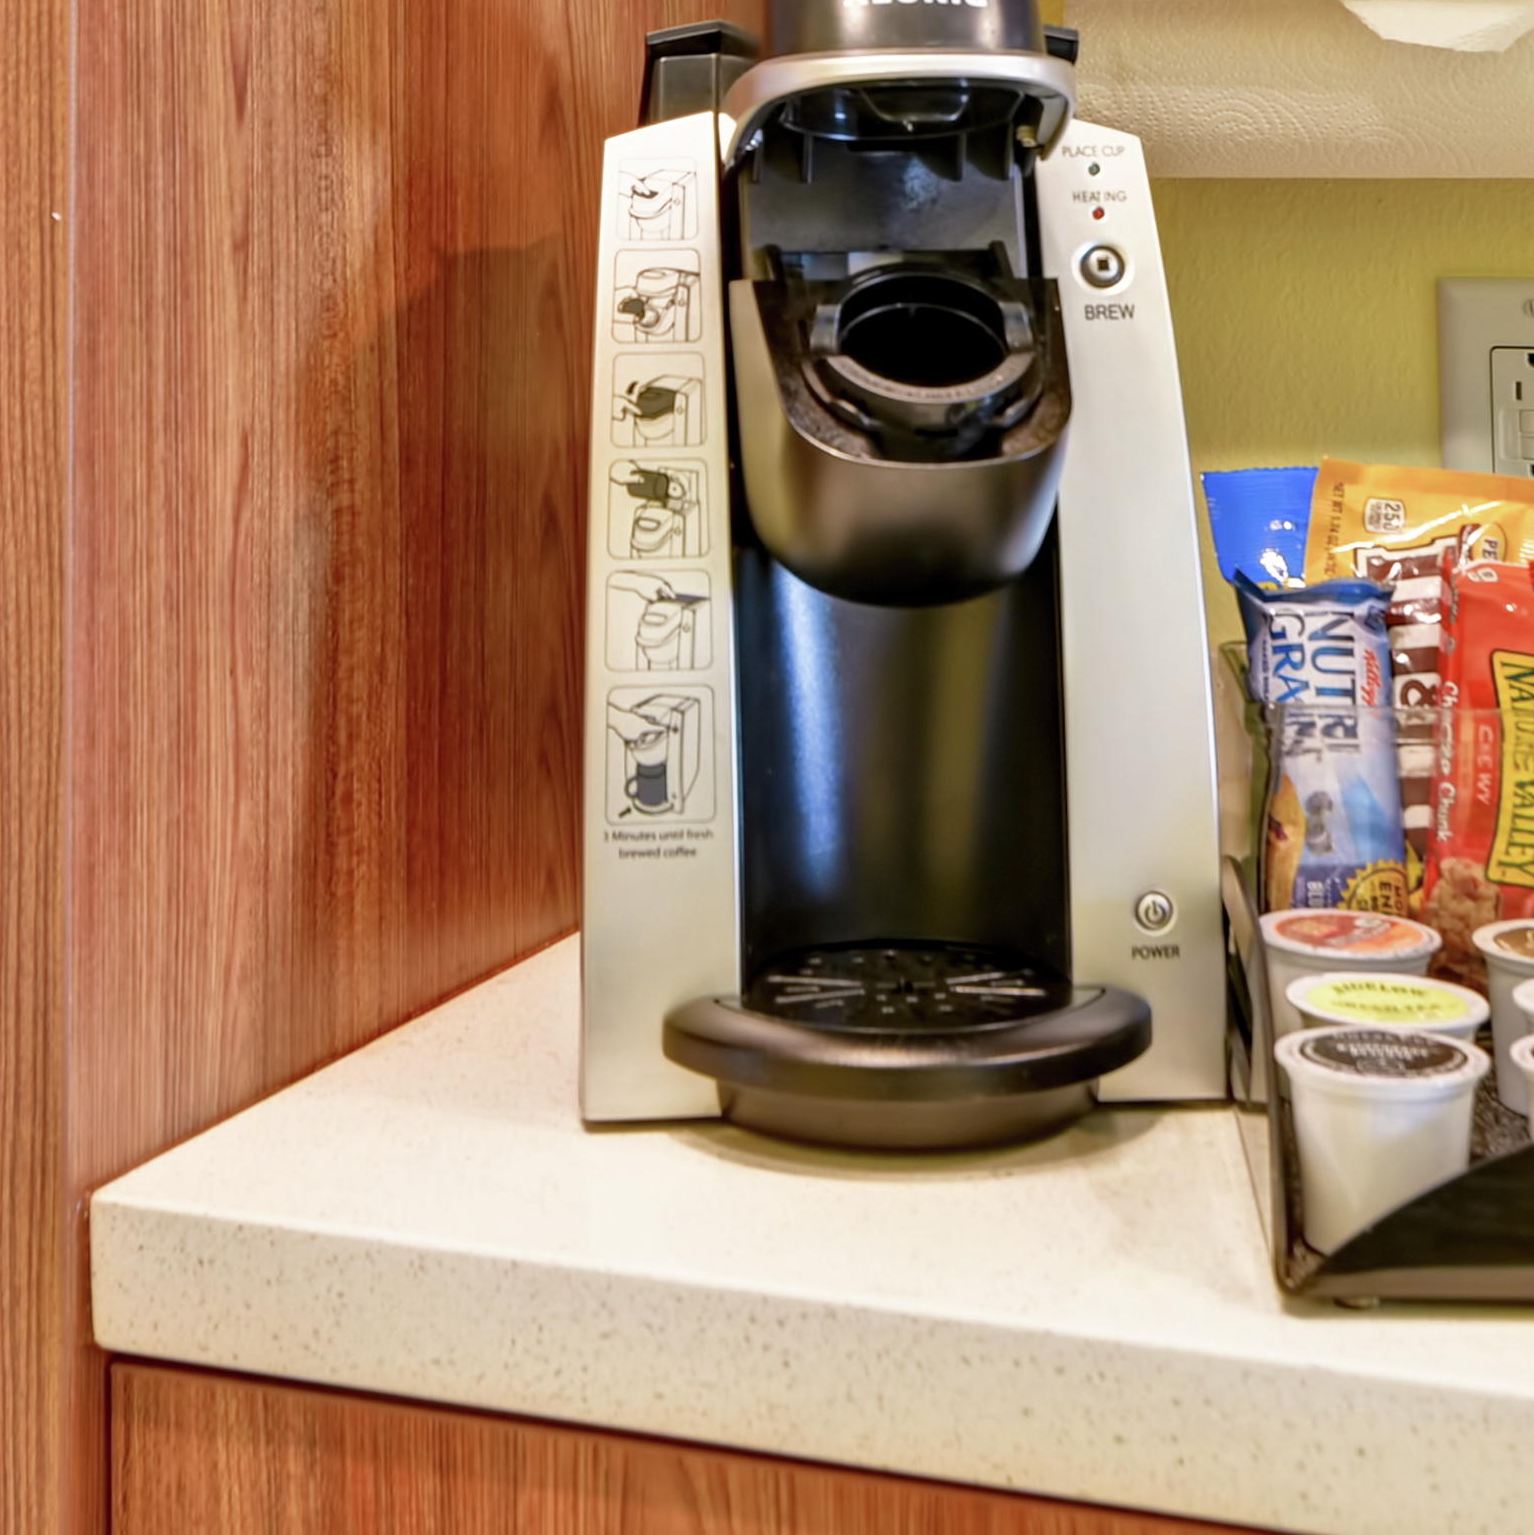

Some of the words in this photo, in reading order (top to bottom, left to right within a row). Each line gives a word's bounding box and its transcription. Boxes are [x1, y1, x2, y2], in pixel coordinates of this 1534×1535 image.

[1062, 146, 1098, 157] PLACE
[1101, 145, 1125, 157] CUP
[1072, 190, 1127, 203] HEATING
[1084, 304, 1135, 321] BREW
[612, 830, 656, 841] Minutes
[658, 829, 684, 840] until
[686, 828, 714, 840] fresh
[618, 847, 660, 859] brewed
[662, 846, 696, 858] coffee
[1131, 945, 1180, 960] POWER
